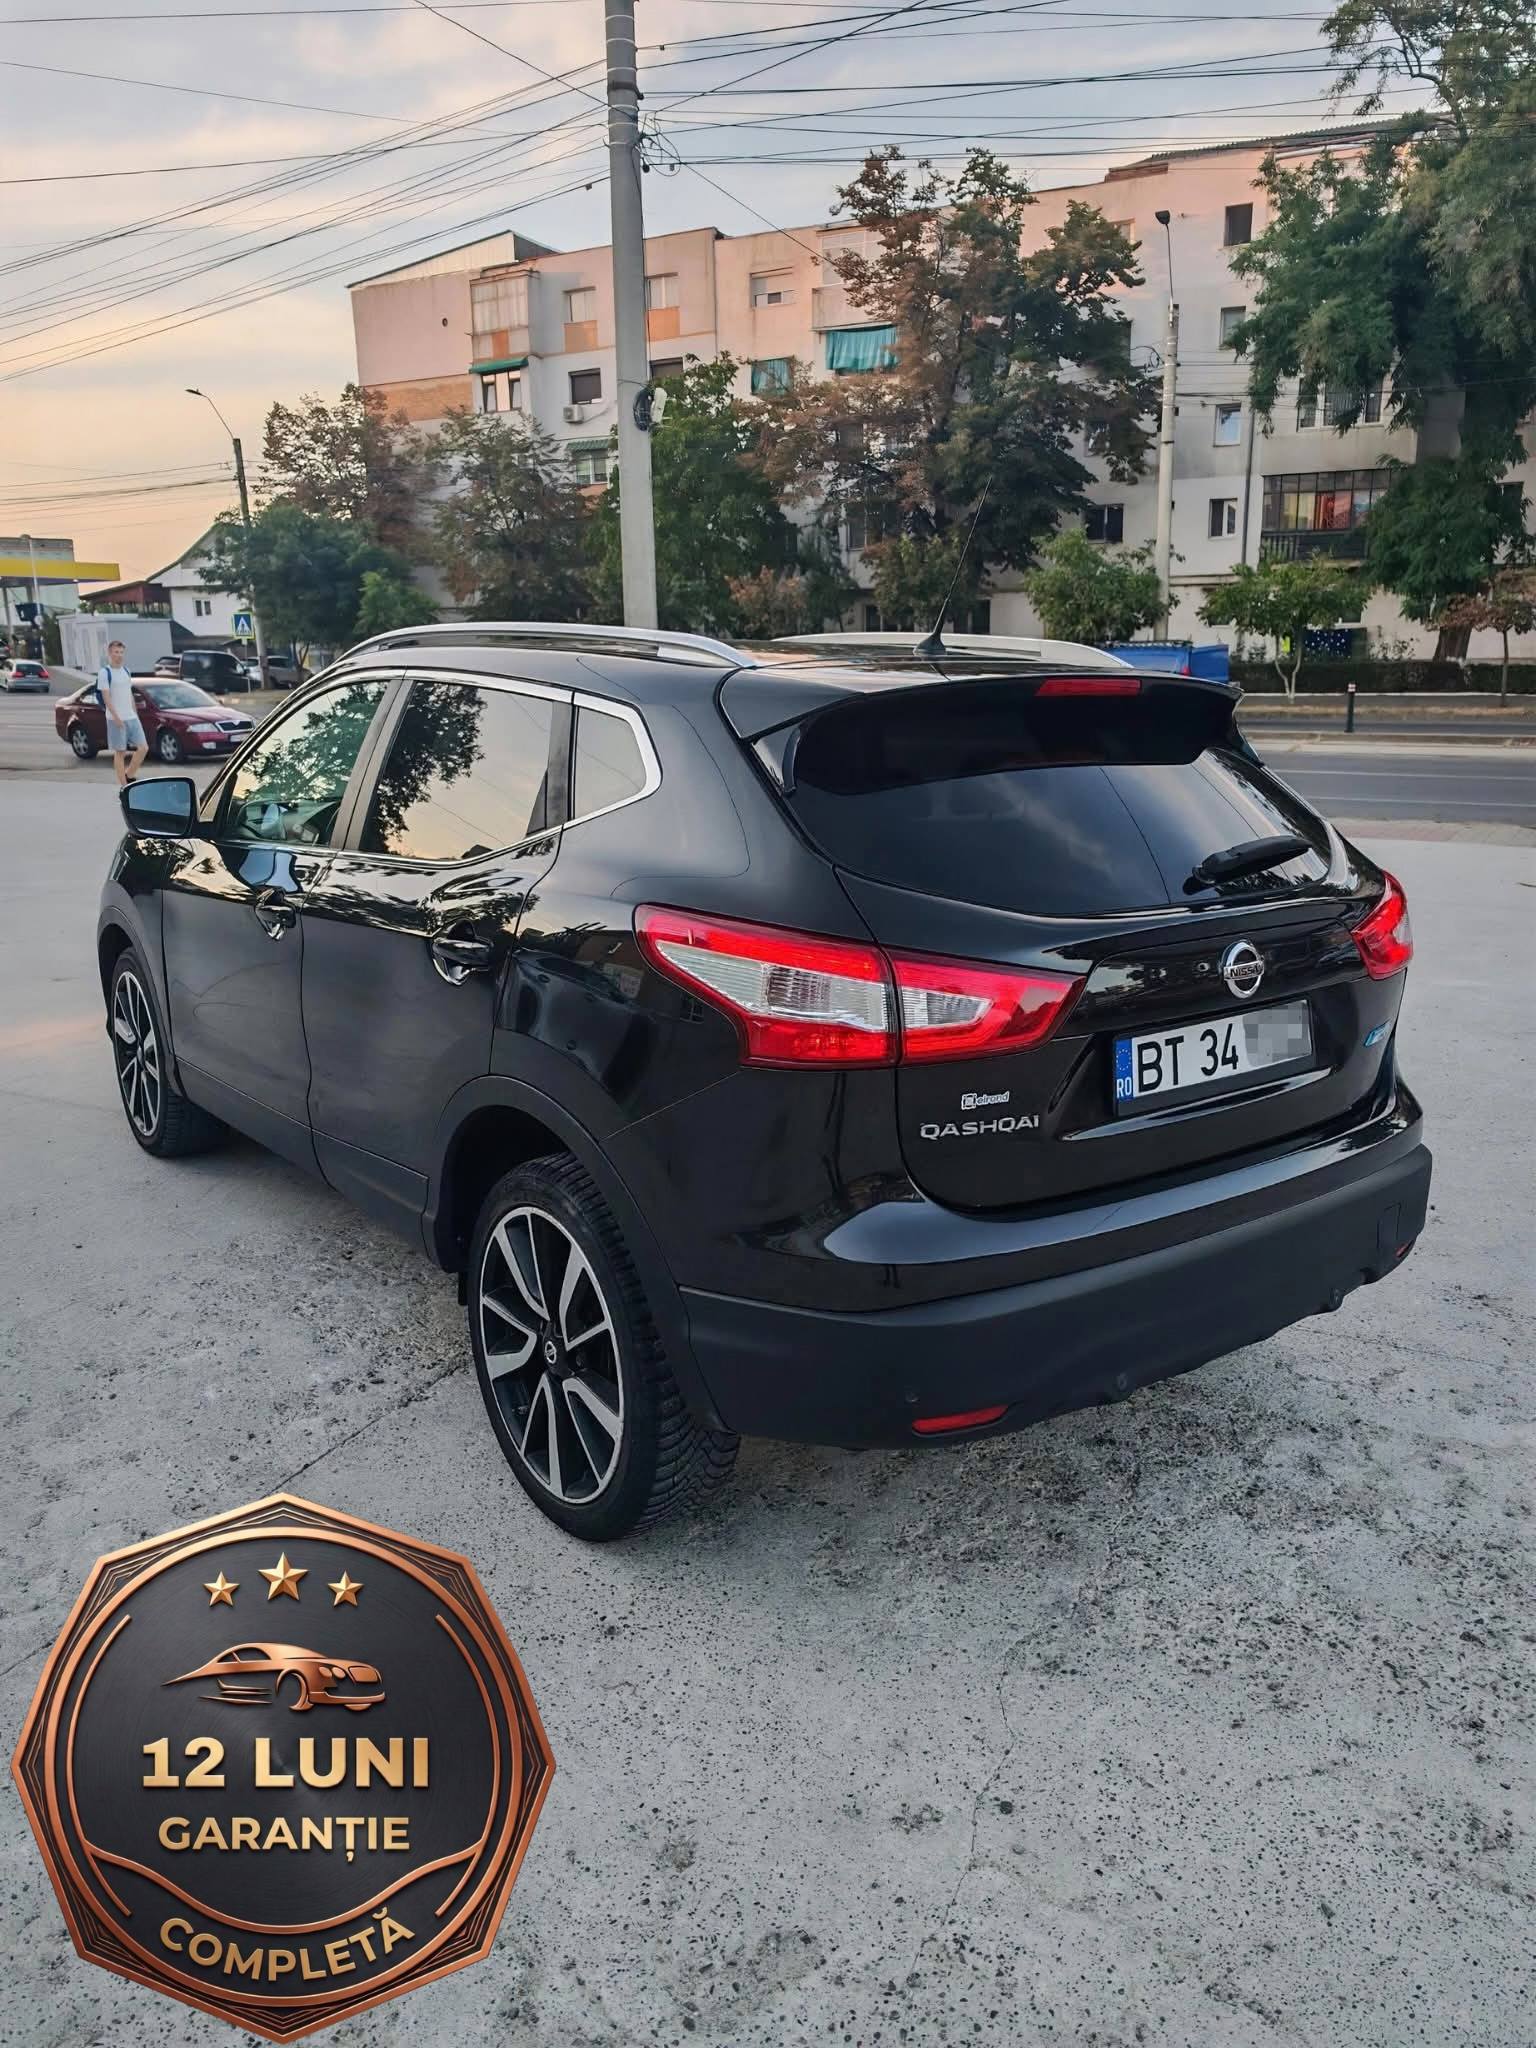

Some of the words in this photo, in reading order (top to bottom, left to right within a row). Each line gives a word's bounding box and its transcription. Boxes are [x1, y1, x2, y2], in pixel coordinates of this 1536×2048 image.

[1137, 1041, 1184, 1093] BT
[1200, 1023, 1239, 1076] 34
[1116, 1077, 1132, 1098] RO
[920, 1115, 1040, 1140] QASHQAI
